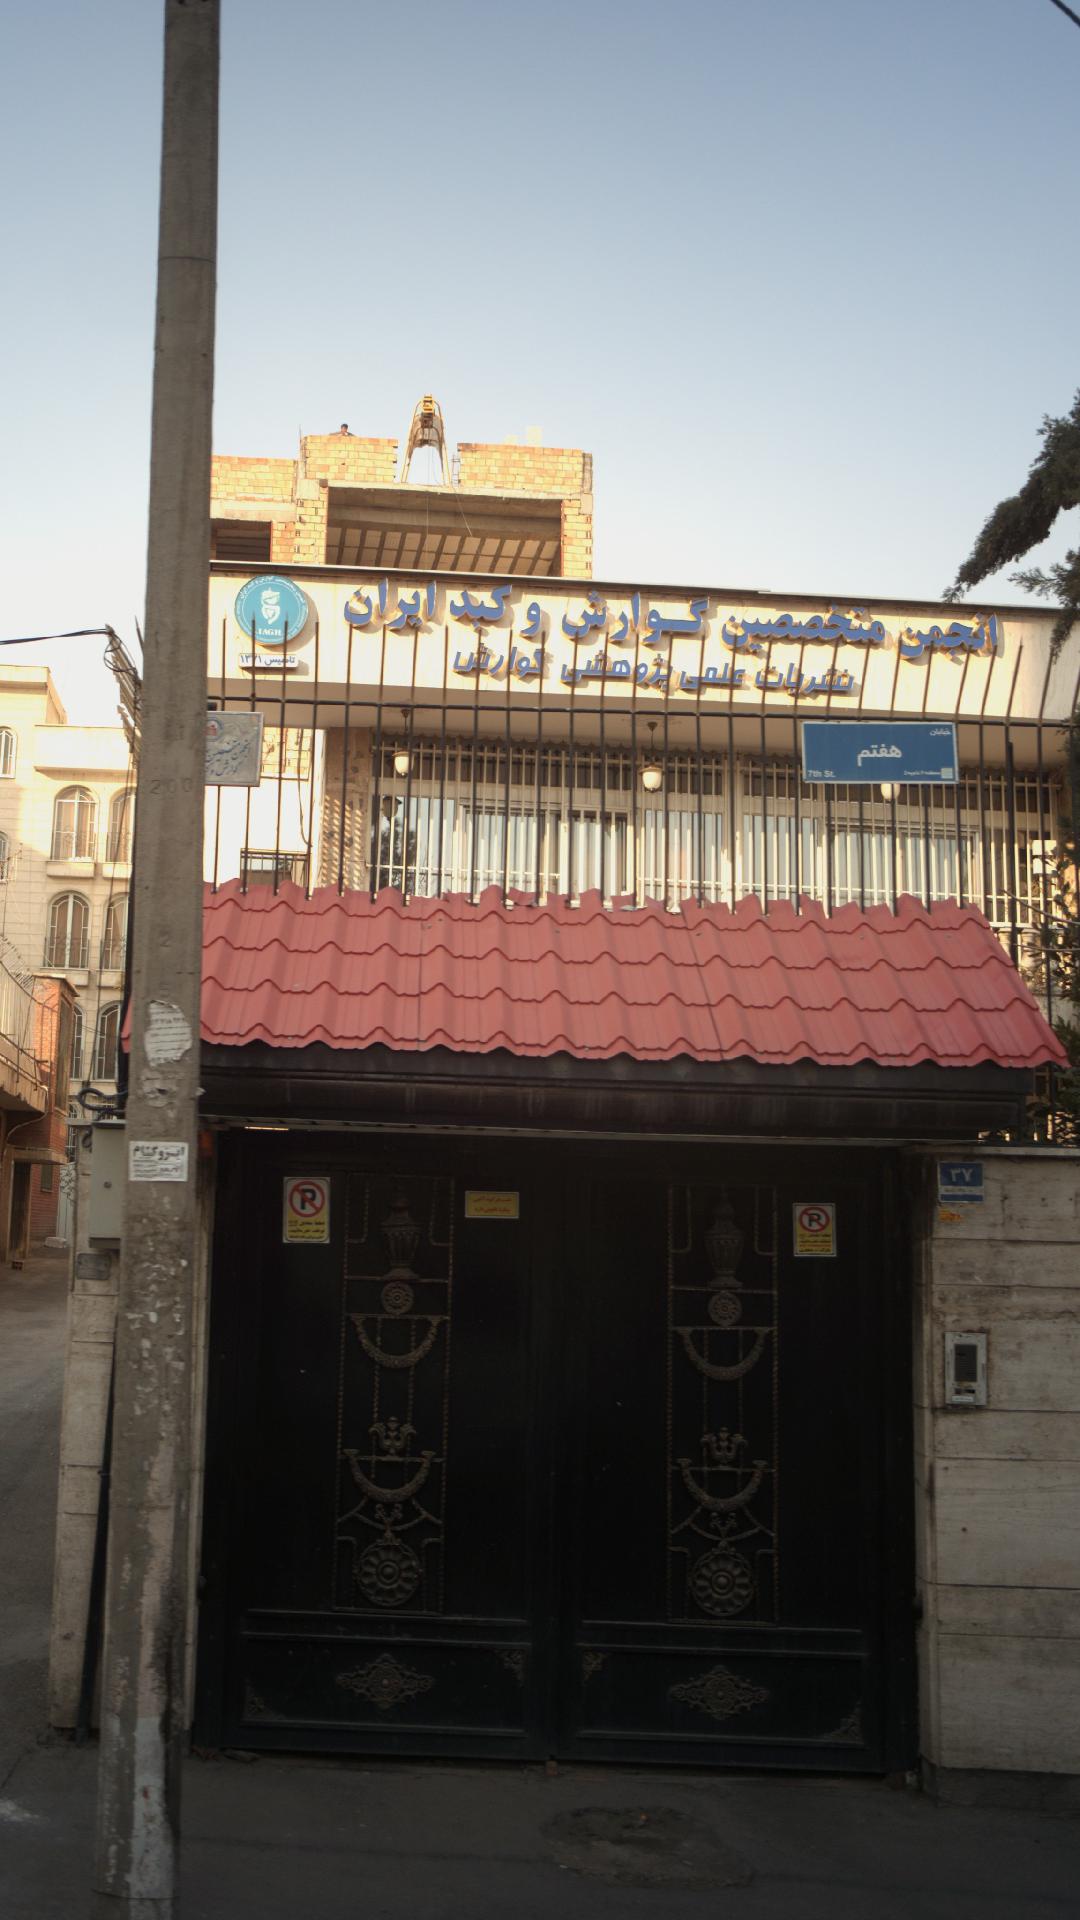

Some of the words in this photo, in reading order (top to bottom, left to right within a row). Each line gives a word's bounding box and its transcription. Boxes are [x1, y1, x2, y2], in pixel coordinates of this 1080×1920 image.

[343, 577, 437, 629] ایران
[449, 584, 512, 630] کبد
[520, 600, 541, 637] و
[562, 589, 708, 643] گوارش
[721, 602, 885, 650] متخصصین
[900, 611, 998, 660] انجمن
[453, 642, 549, 678] گوارش
[560, 647, 672, 692] پژوهشی
[680, 661, 745, 691] علمی
[754, 662, 855, 696] نشریات
[857, 743, 903, 767] هفتم
[808, 770, 823, 778] 7th
[824, 770, 836, 778] St.
[950, 1167, 973, 1182] ۳۷
